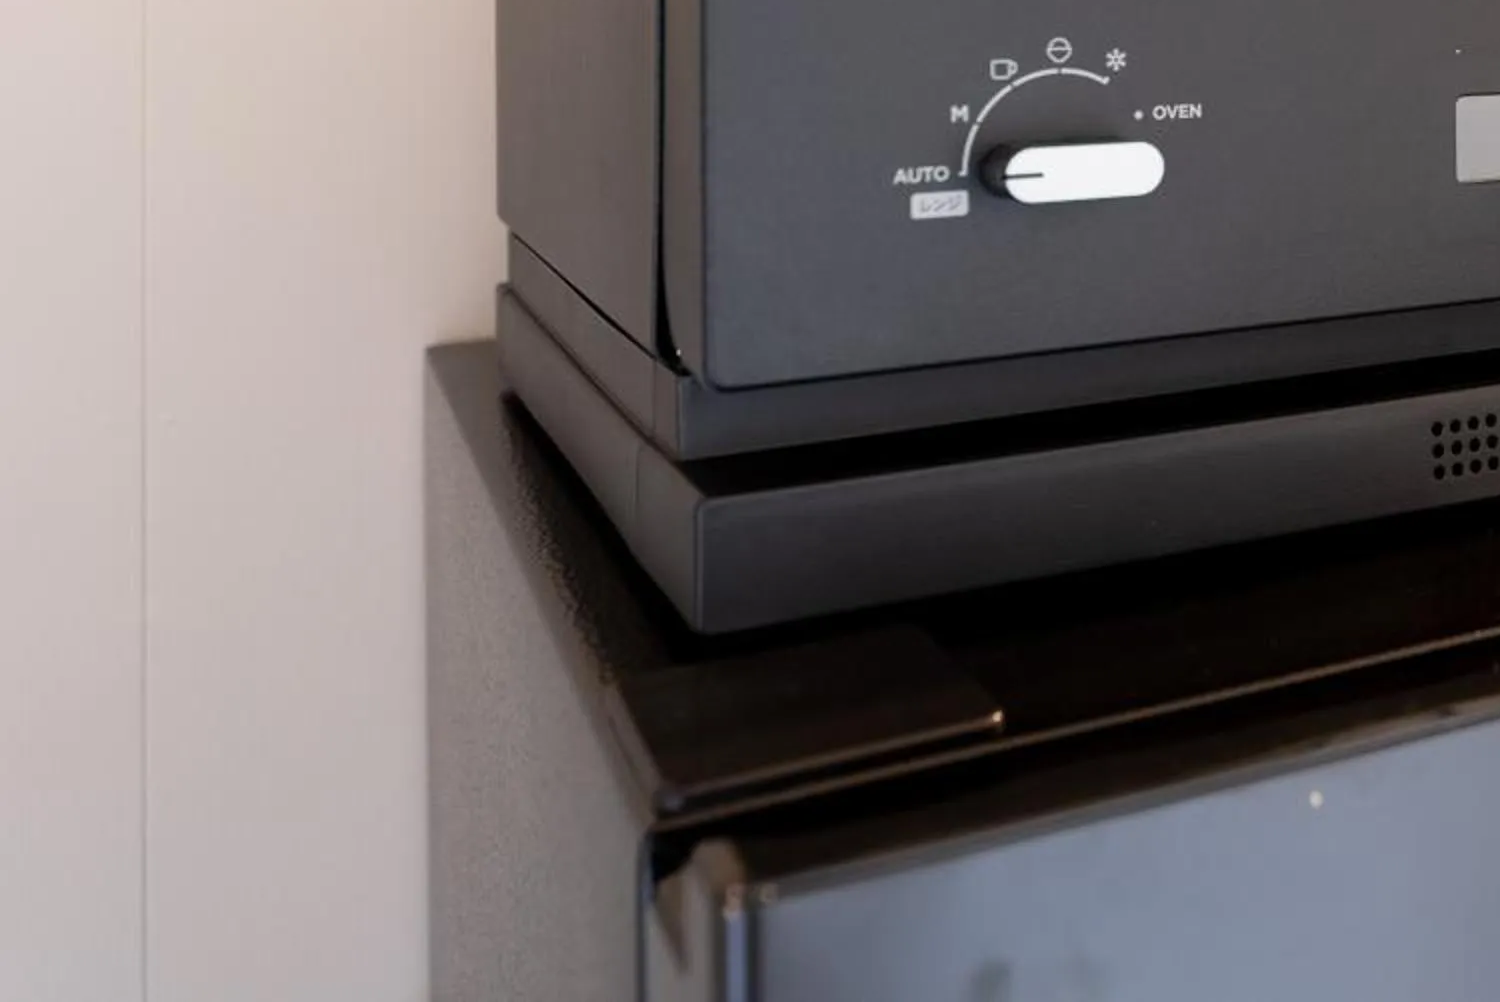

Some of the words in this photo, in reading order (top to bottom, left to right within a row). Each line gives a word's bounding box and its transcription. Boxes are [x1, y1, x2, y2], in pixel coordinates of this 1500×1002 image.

[950, 105, 969, 123] M
[1152, 103, 1203, 120] OVEN
[893, 166, 951, 185] AUTO
